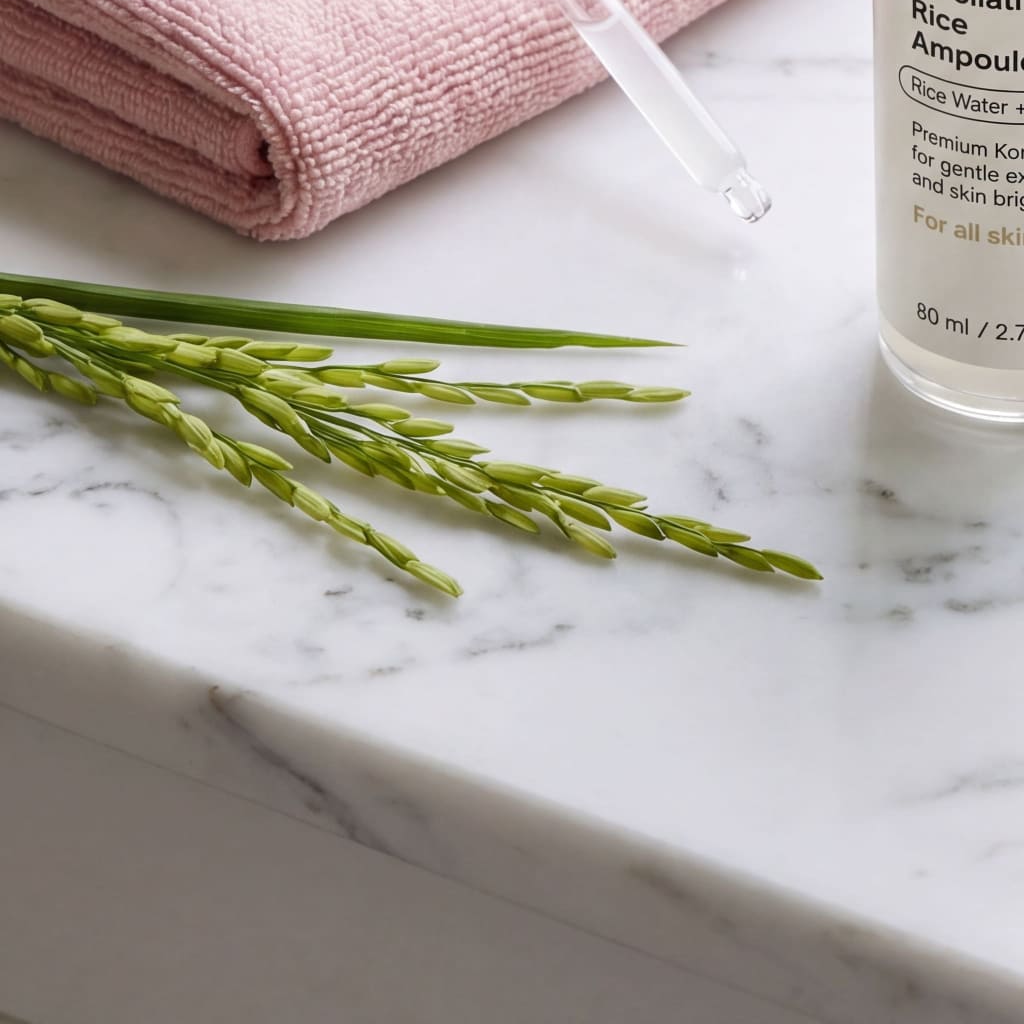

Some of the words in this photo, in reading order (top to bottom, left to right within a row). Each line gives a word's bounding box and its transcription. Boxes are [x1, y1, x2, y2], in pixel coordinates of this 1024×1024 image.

[911, 74, 947, 104] Rice
[951, 90, 1009, 115] Water
[911, 120, 988, 158] Premium
[911, 144, 935, 167] for
[940, 160, 1000, 183] gentle
[911, 171, 944, 195] and
[949, 183, 987, 205] skin
[913, 204, 948, 233] For
[953, 222, 980, 243] all
[916, 301, 939, 326] 80
[945, 317, 969, 336] ml
[976, 321, 990, 339] /
